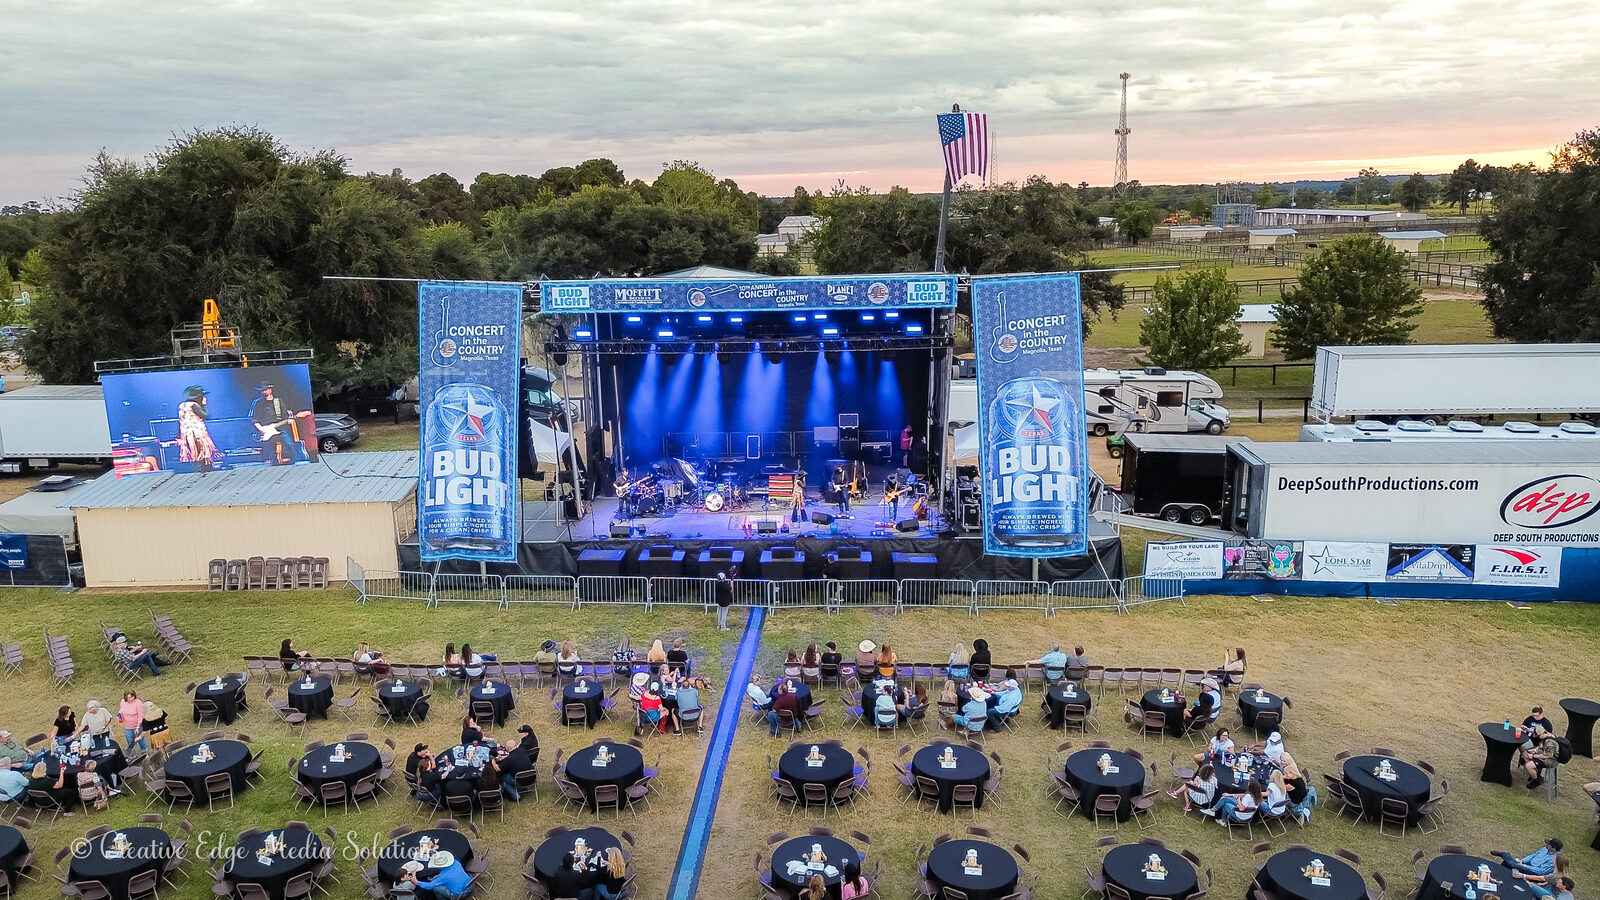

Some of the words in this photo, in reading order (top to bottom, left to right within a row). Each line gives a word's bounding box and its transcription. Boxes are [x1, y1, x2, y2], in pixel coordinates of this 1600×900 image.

[750, 283, 776, 291] ANNUAL
[827, 284, 854, 296] PLANET
[914, 283, 939, 292] BUD
[558, 288, 583, 298] BUD
[615, 288, 662, 301] MOFFITT
[738, 289, 778, 299] CONCERT
[909, 292, 944, 302] LIGHT
[554, 297, 588, 307] LIGHT
[776, 294, 809, 303] COUNTRY
[1008, 315, 1067, 331] CONCERT
[449, 325, 506, 336] CONCERT
[1023, 330, 1032, 339] in
[1033, 329, 1049, 337] the
[462, 337, 471, 345] in
[473, 337, 488, 345] the
[1019, 335, 1068, 349] COUNTRY
[458, 345, 505, 355] COUNTRY
[1022, 348, 1048, 356] Magnolia,
[433, 449, 501, 478] BUD
[999, 445, 1071, 475] BUD
[992, 473, 1079, 505] LIGHT
[1277, 477, 1479, 494] DeepSouthProductions.com
[425, 476, 508, 508] LIGHT
[1512, 483, 1593, 525] dsp
[1493, 533, 1514, 542] DEEP
[1516, 533, 1543, 542] SOUTH
[1544, 533, 1600, 544] PRODUCTIONS
[1325, 557, 1349, 565] LONE
[1350, 557, 1372, 565] STAR
[1491, 565, 1548, 574] F.I.R.S.T.
